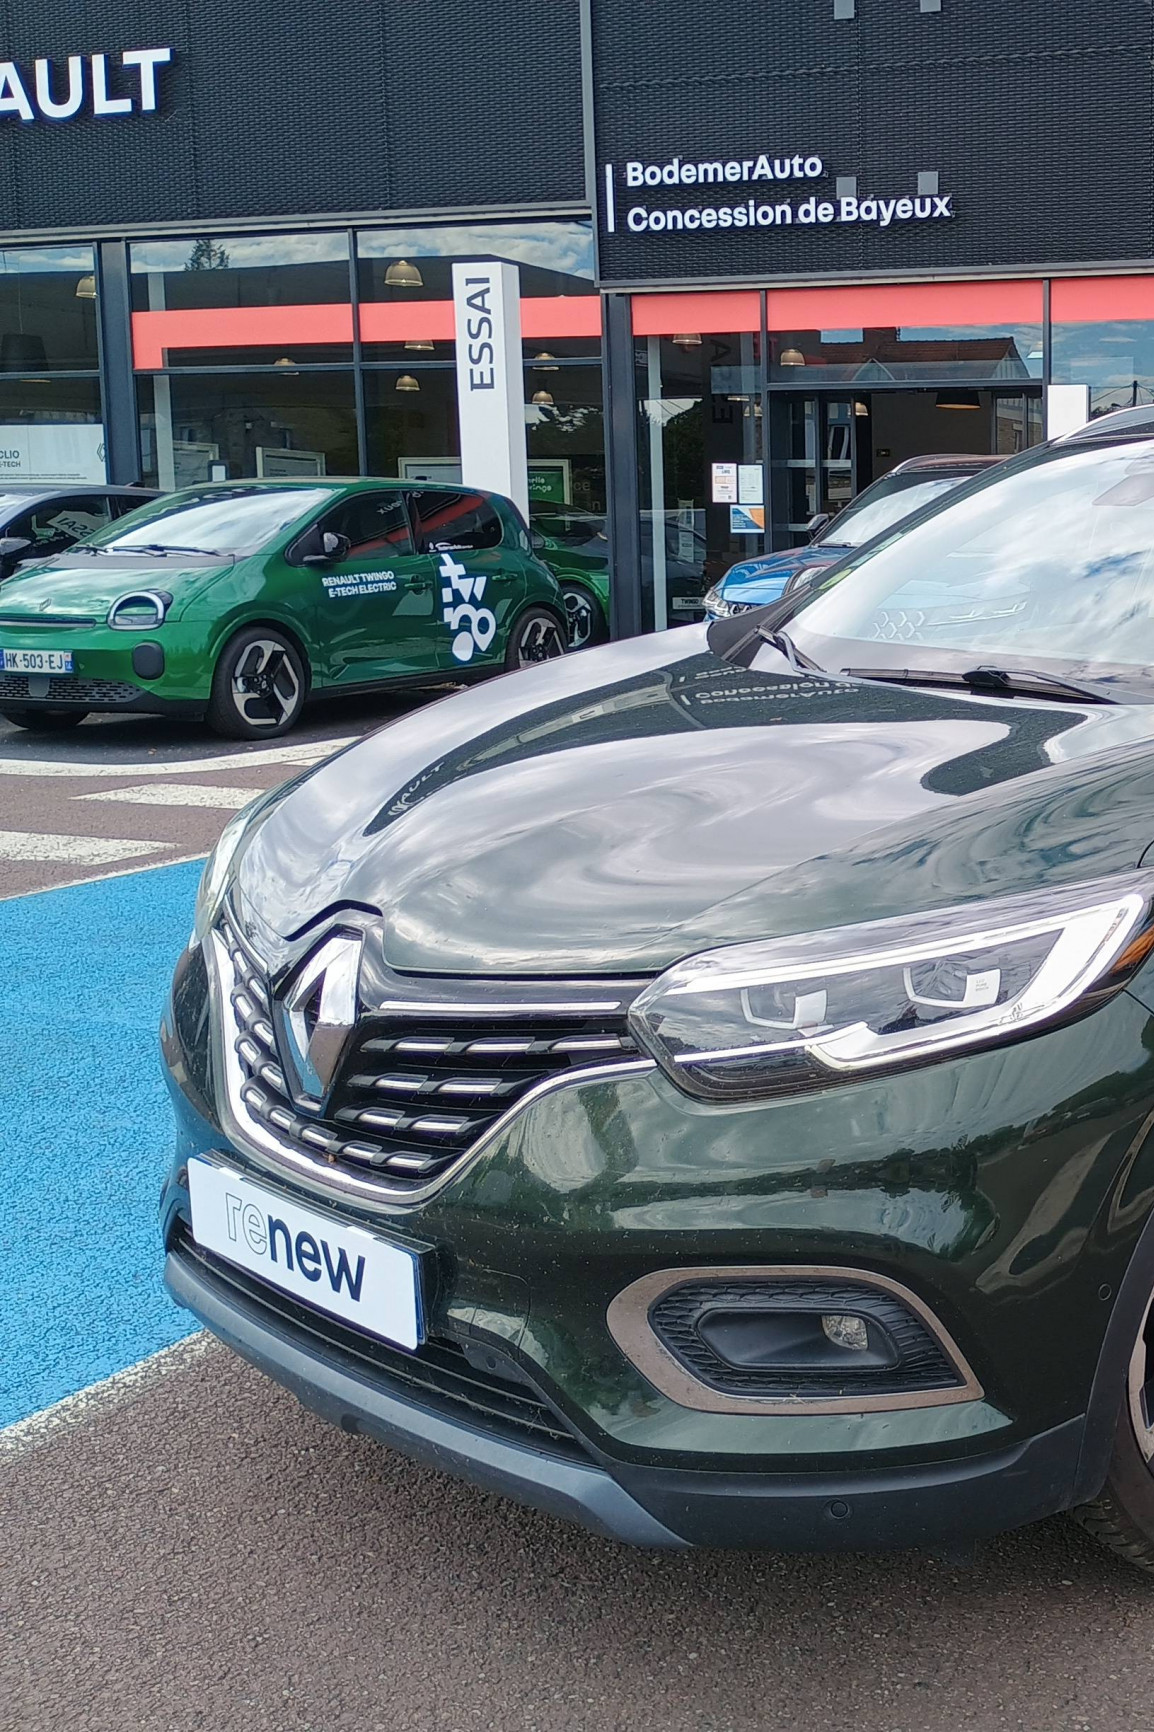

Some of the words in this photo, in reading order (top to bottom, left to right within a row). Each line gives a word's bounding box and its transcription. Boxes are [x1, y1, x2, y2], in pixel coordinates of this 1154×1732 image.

[626, 154, 823, 187] BodemerAuto
[627, 204, 792, 232] Concession
[798, 196, 834, 224] de
[840, 196, 952, 226] Bayeux
[464, 276, 495, 392] ESSAI
[321, 573, 360, 587] RENAULT
[360, 570, 395, 583] TWINGO
[328, 585, 360, 598] E-TECH
[359, 581, 397, 594] ELECTRIC
[5, 652, 63, 670] HK-503-EJ
[225, 1192, 366, 1303] renew
